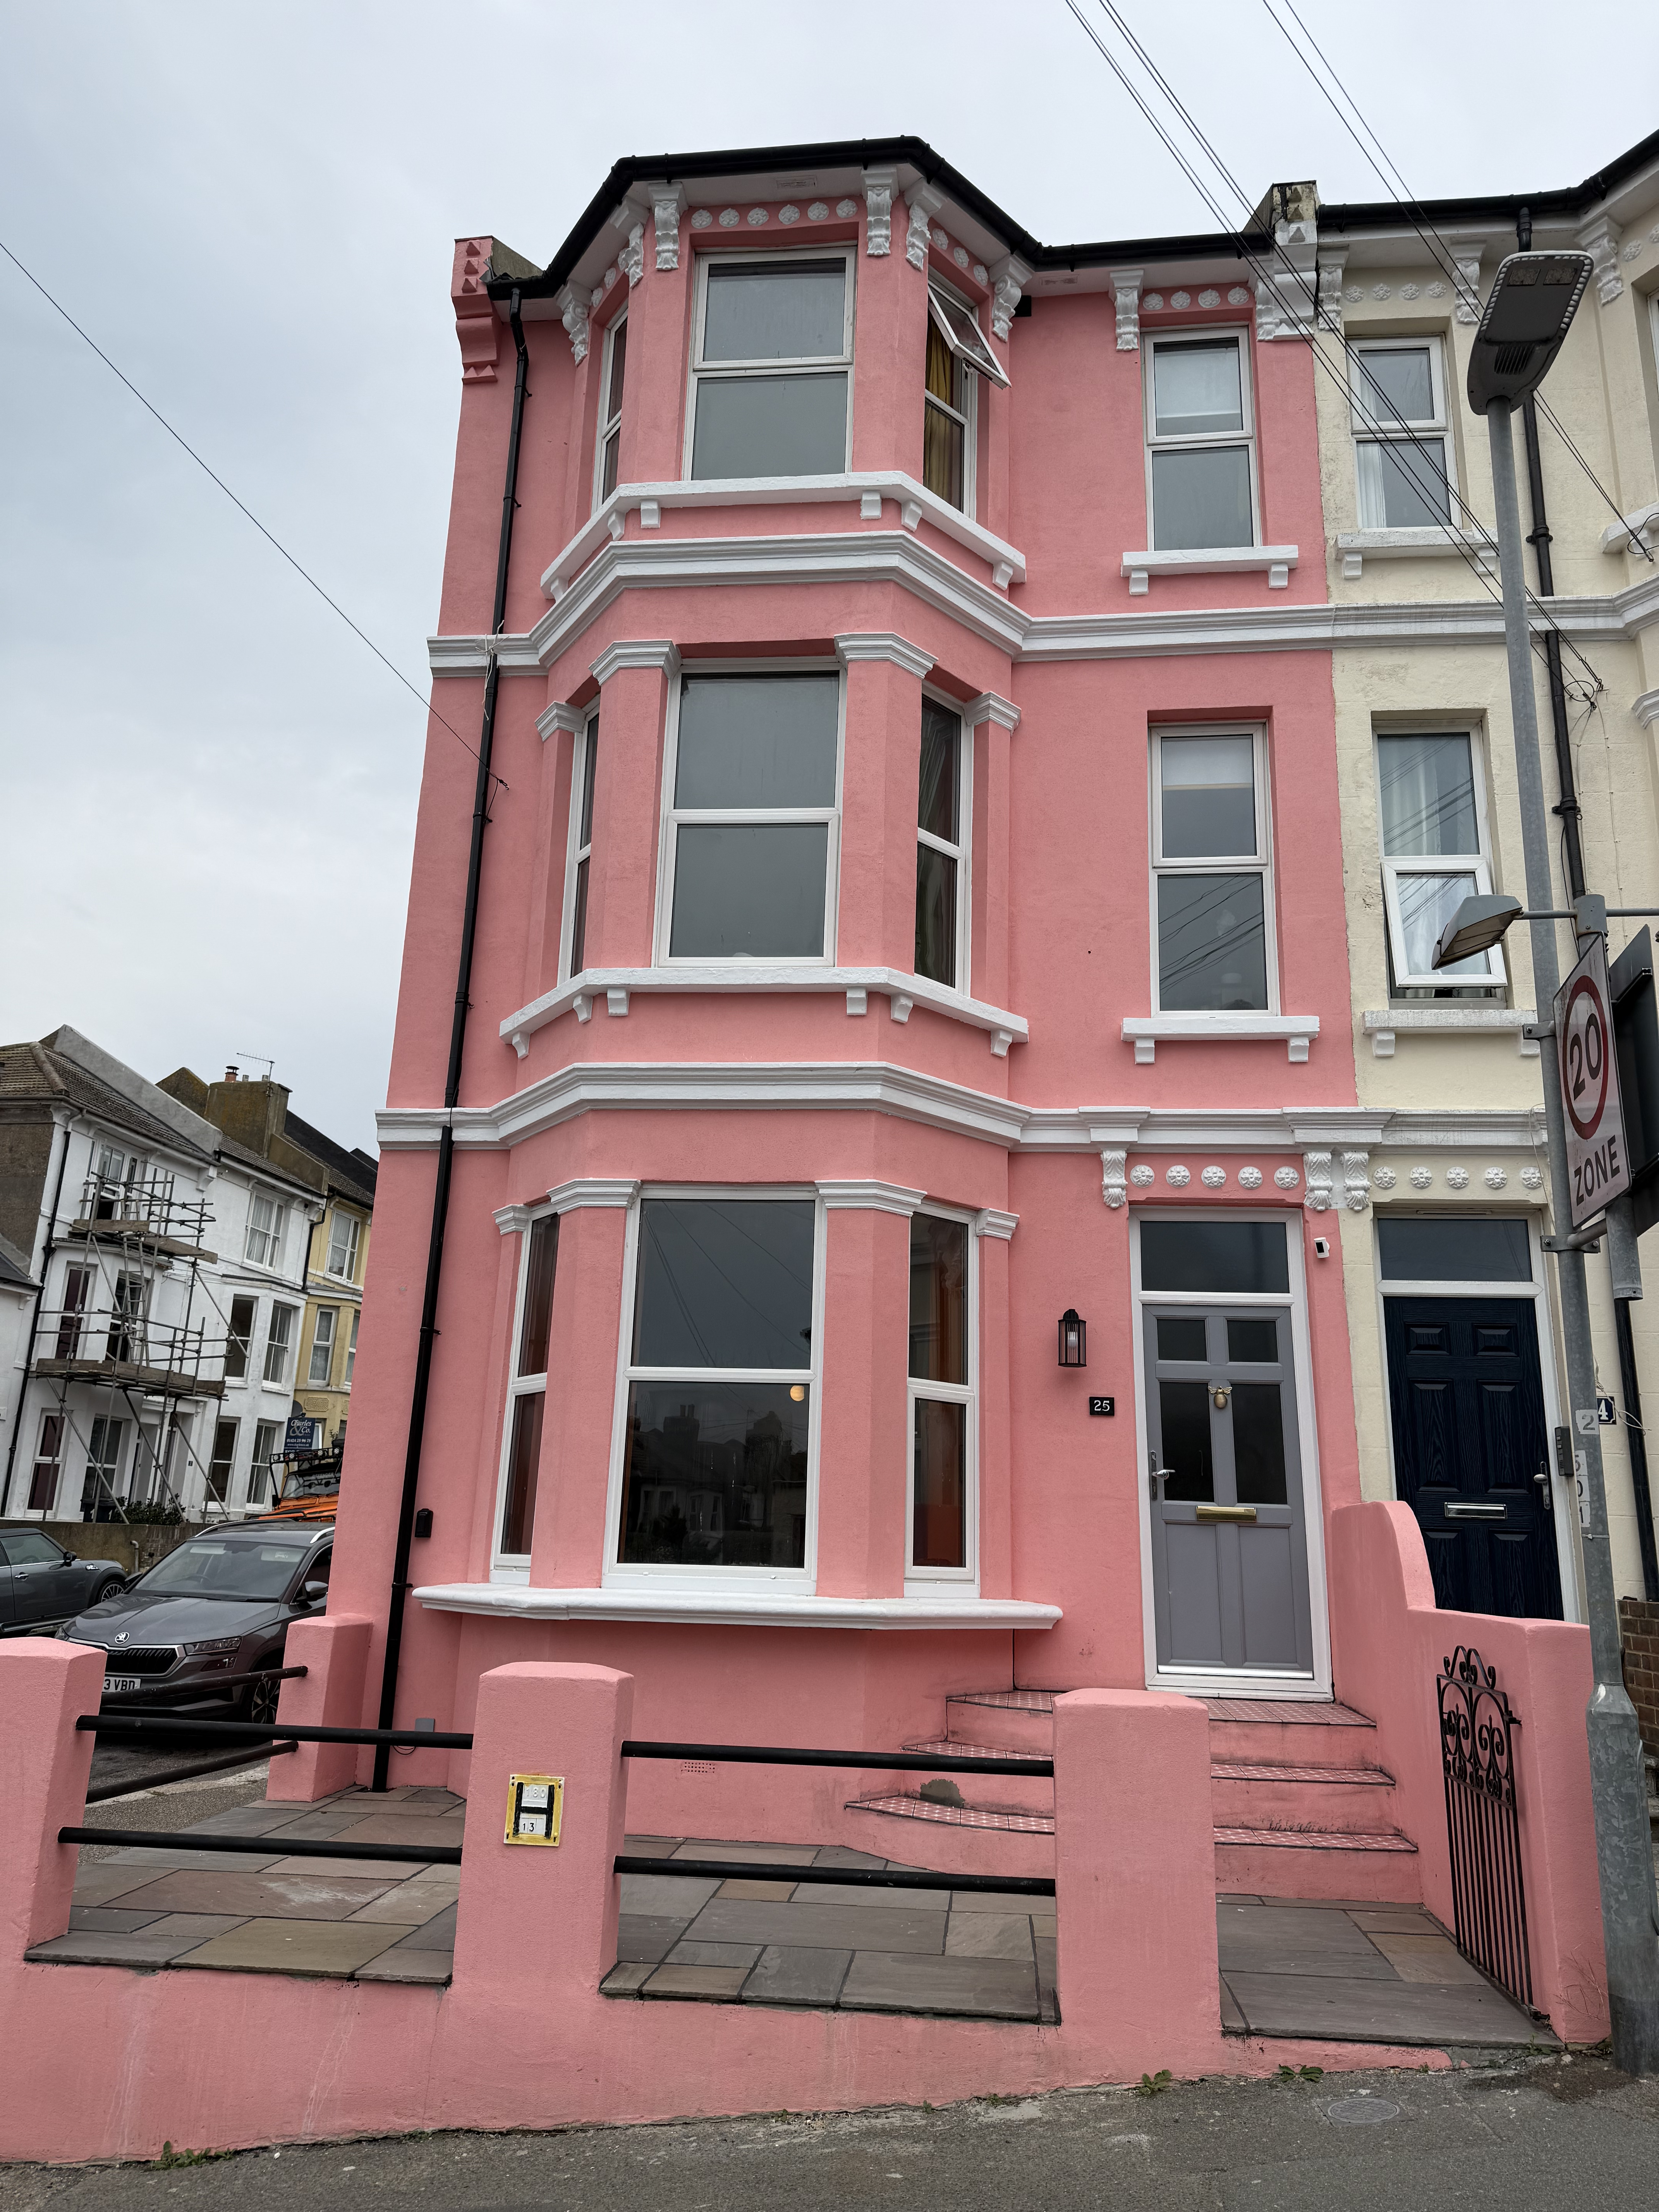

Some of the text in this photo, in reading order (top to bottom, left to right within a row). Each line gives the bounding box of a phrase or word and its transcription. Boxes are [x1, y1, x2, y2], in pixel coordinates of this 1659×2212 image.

[1570, 1013, 1602, 1101] 20
[1574, 1134, 1620, 1207] ZONE
[1094, 1400, 1110, 1412] 25
[1598, 1399, 1609, 1420] 4
[1582, 1414, 1595, 1431] 2
[526, 1787, 546, 1798] 180
[522, 1822, 534, 1832] 13
